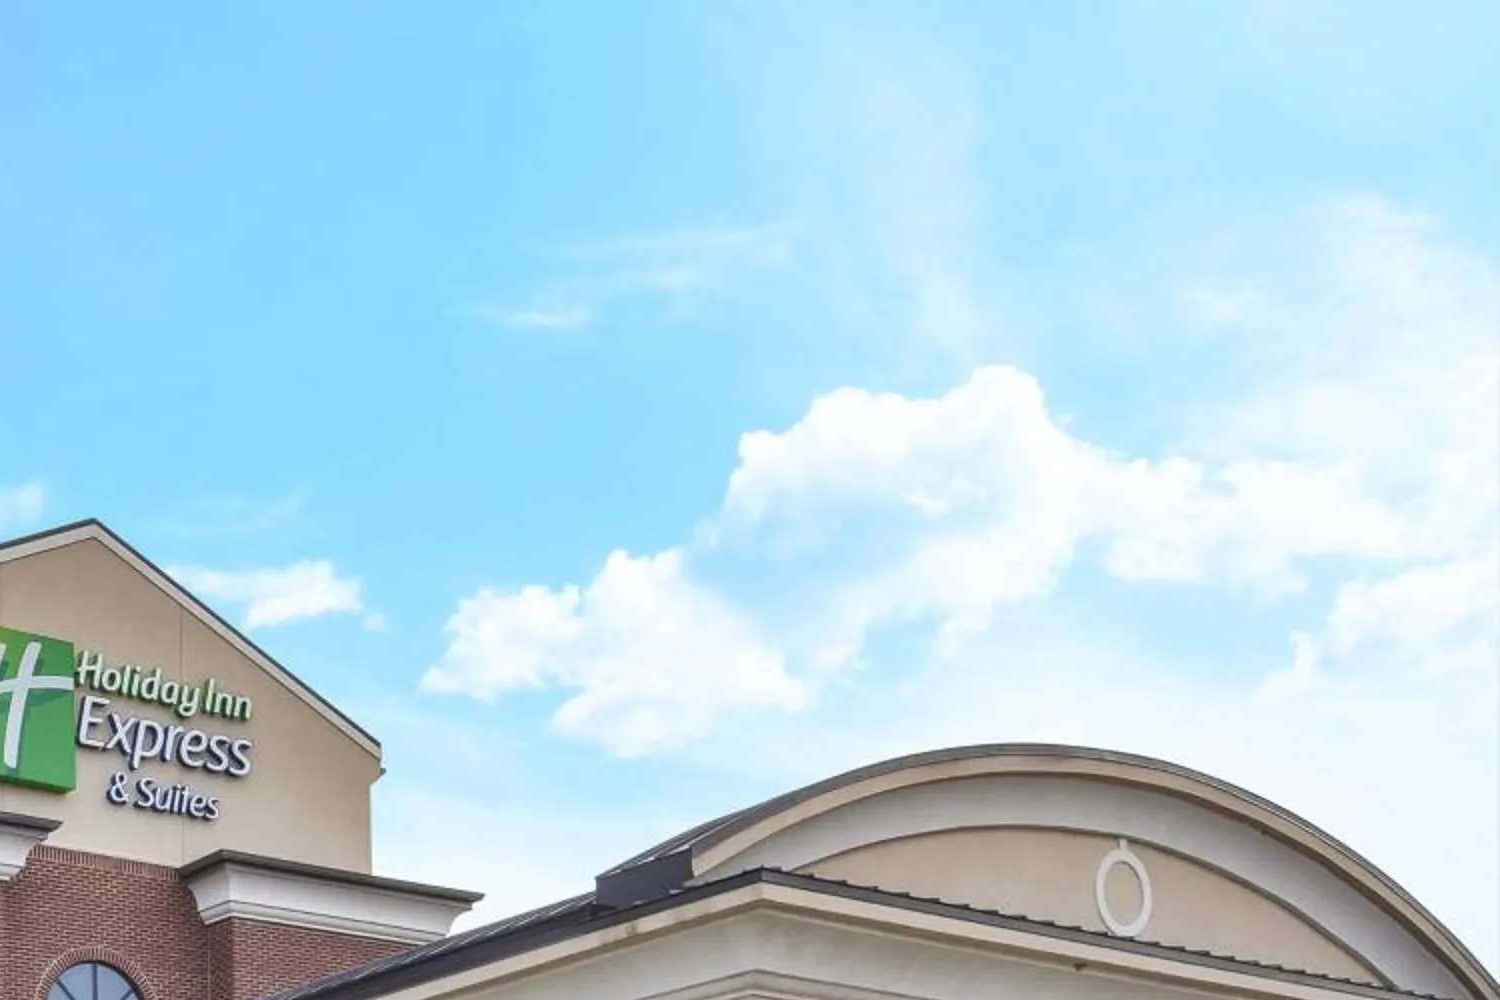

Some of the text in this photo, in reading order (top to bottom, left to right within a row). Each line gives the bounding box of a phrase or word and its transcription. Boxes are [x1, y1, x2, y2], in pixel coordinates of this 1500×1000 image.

[76, 649, 252, 720] Holiday Inn
[77, 694, 252, 777] Express
[107, 771, 221, 820] & Suites
